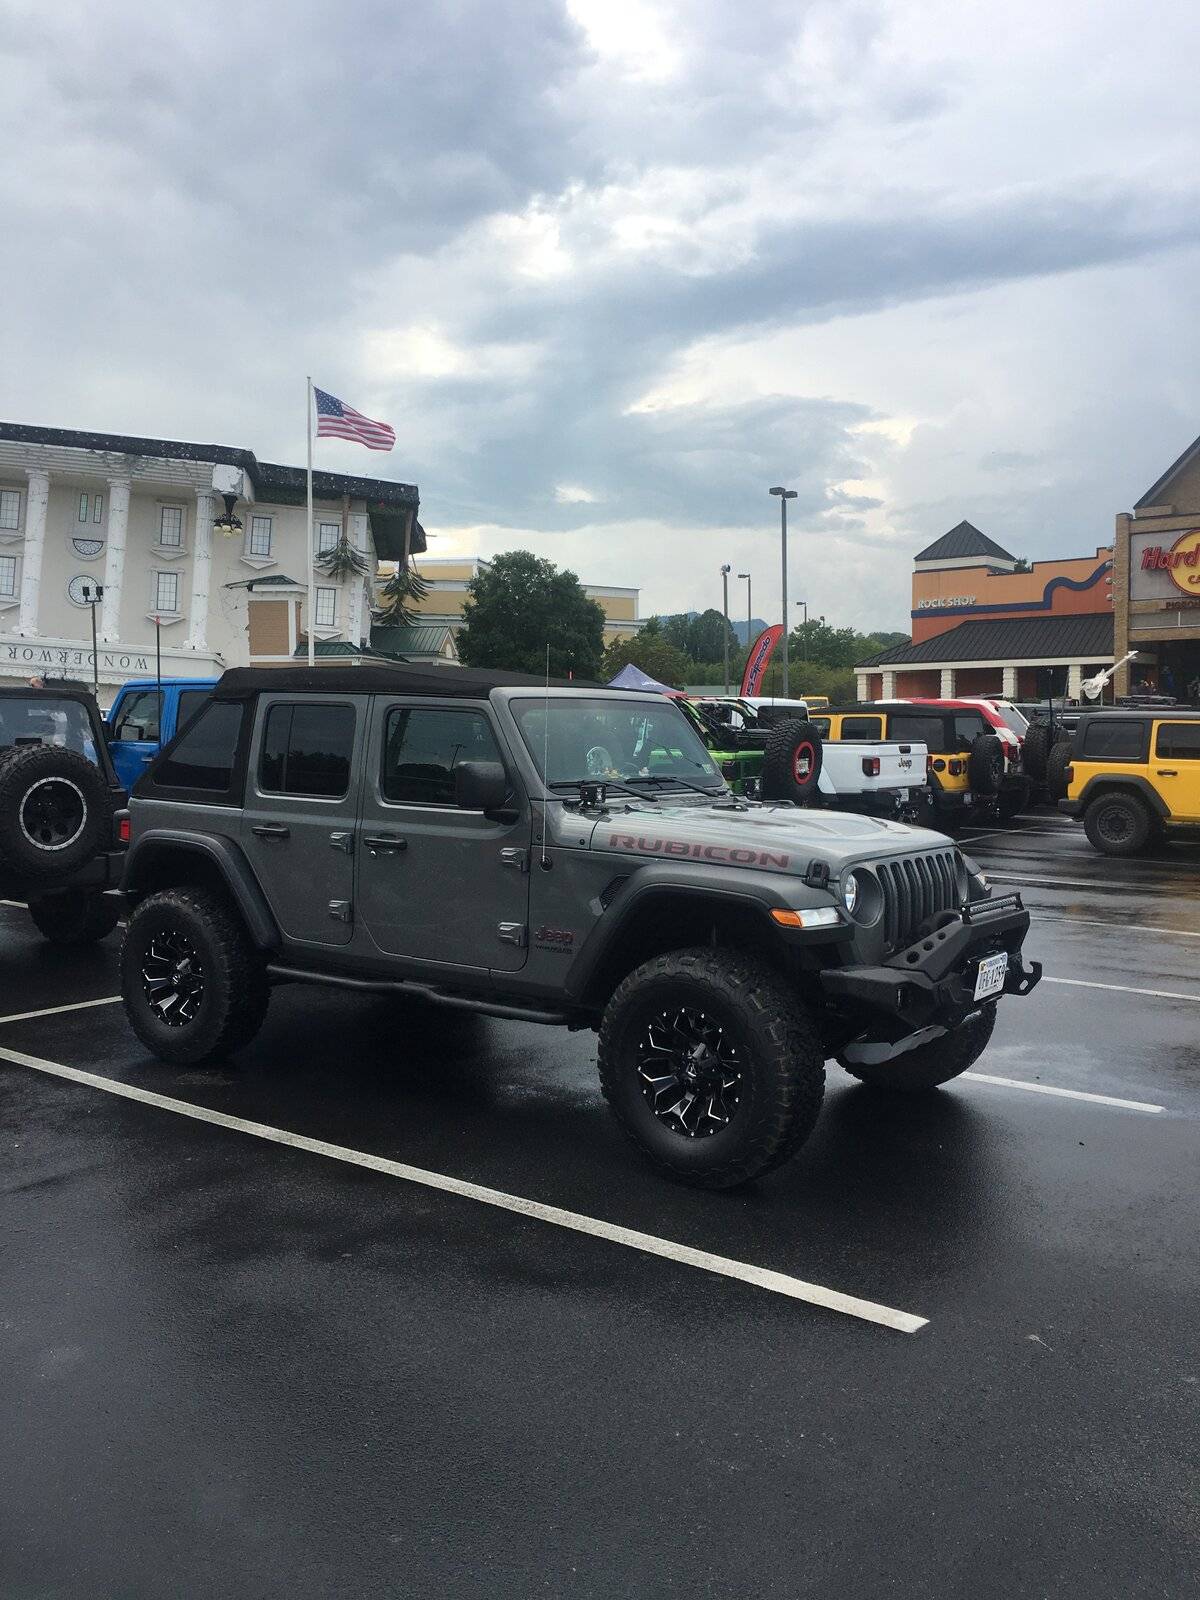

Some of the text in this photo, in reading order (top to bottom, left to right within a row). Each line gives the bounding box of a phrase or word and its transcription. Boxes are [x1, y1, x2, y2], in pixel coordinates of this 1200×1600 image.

[1141, 543, 1200, 570] Hard
[918, 594, 976, 609] ROCK SHOP
[609, 833, 790, 868] RUBICON
[535, 926, 576, 943] Jeep
